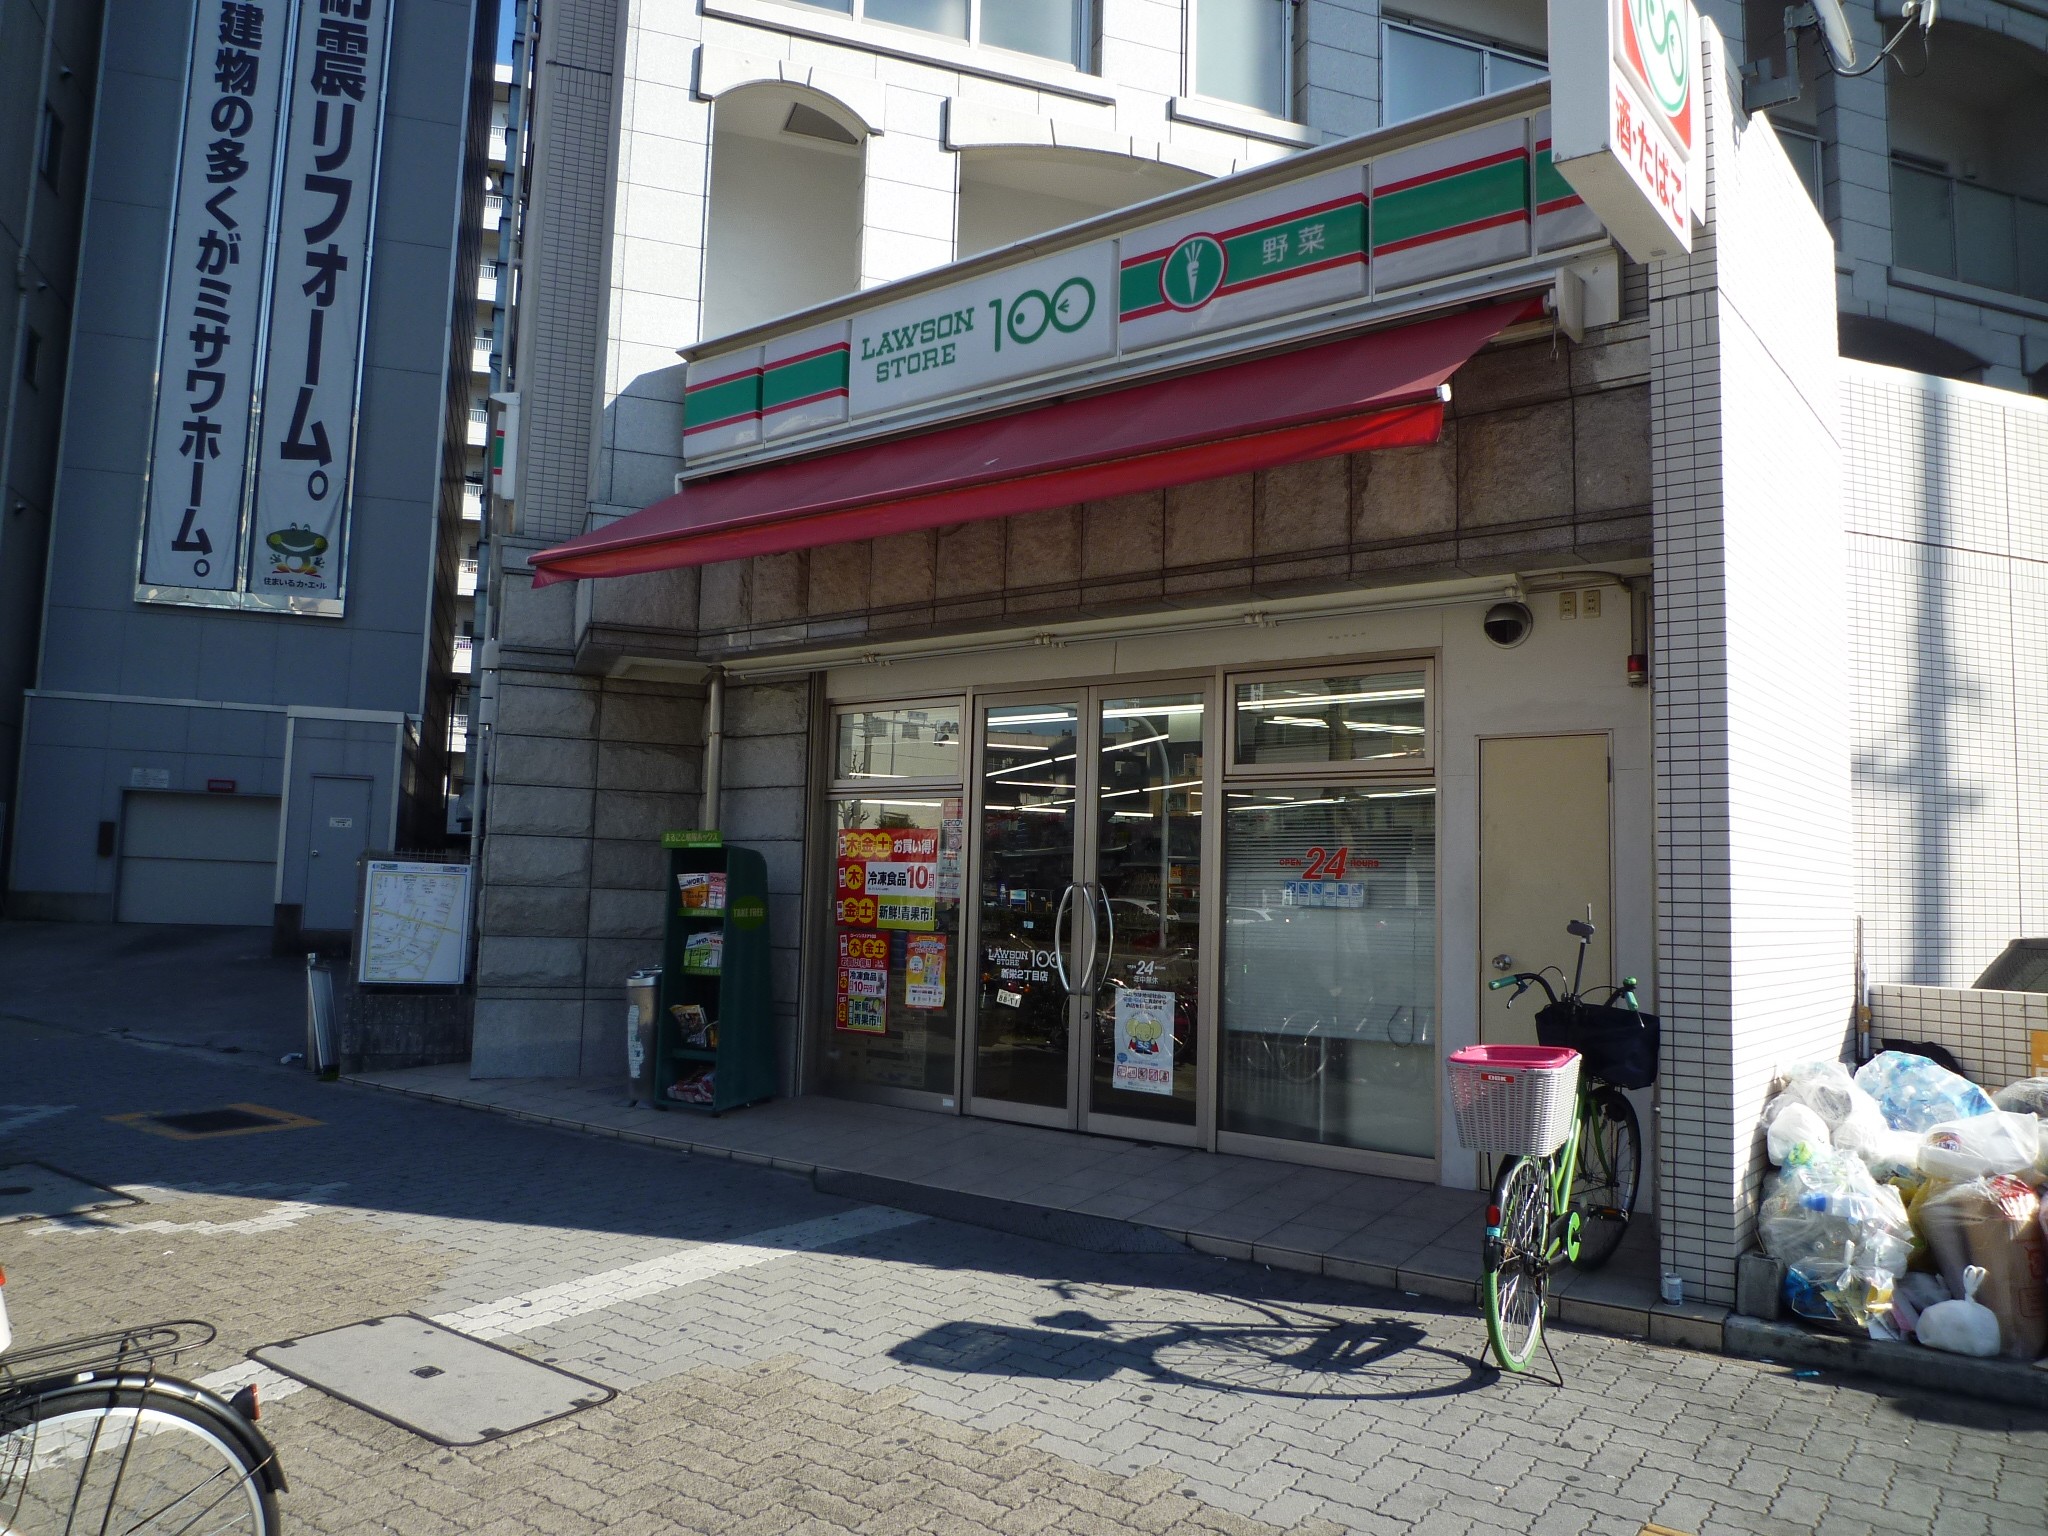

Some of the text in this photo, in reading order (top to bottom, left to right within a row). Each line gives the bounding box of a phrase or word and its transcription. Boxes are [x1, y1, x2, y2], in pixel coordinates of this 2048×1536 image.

[1615, 83, 1684, 229] 酒・たばこ
[279, 0, 370, 501] 震リフォーム。
[1261, 223, 1327, 267] 野菜
[861, 306, 976, 361] LAWSON
[988, 276, 1096, 353] 100
[875, 342, 957, 384] STORE
[1279, 845, 1380, 880] OPEN 24 HOURS
[988, 948, 1029, 961] LAWSON
[996, 959, 1020, 967] STORE
[1136, 960, 1155, 976] 24
